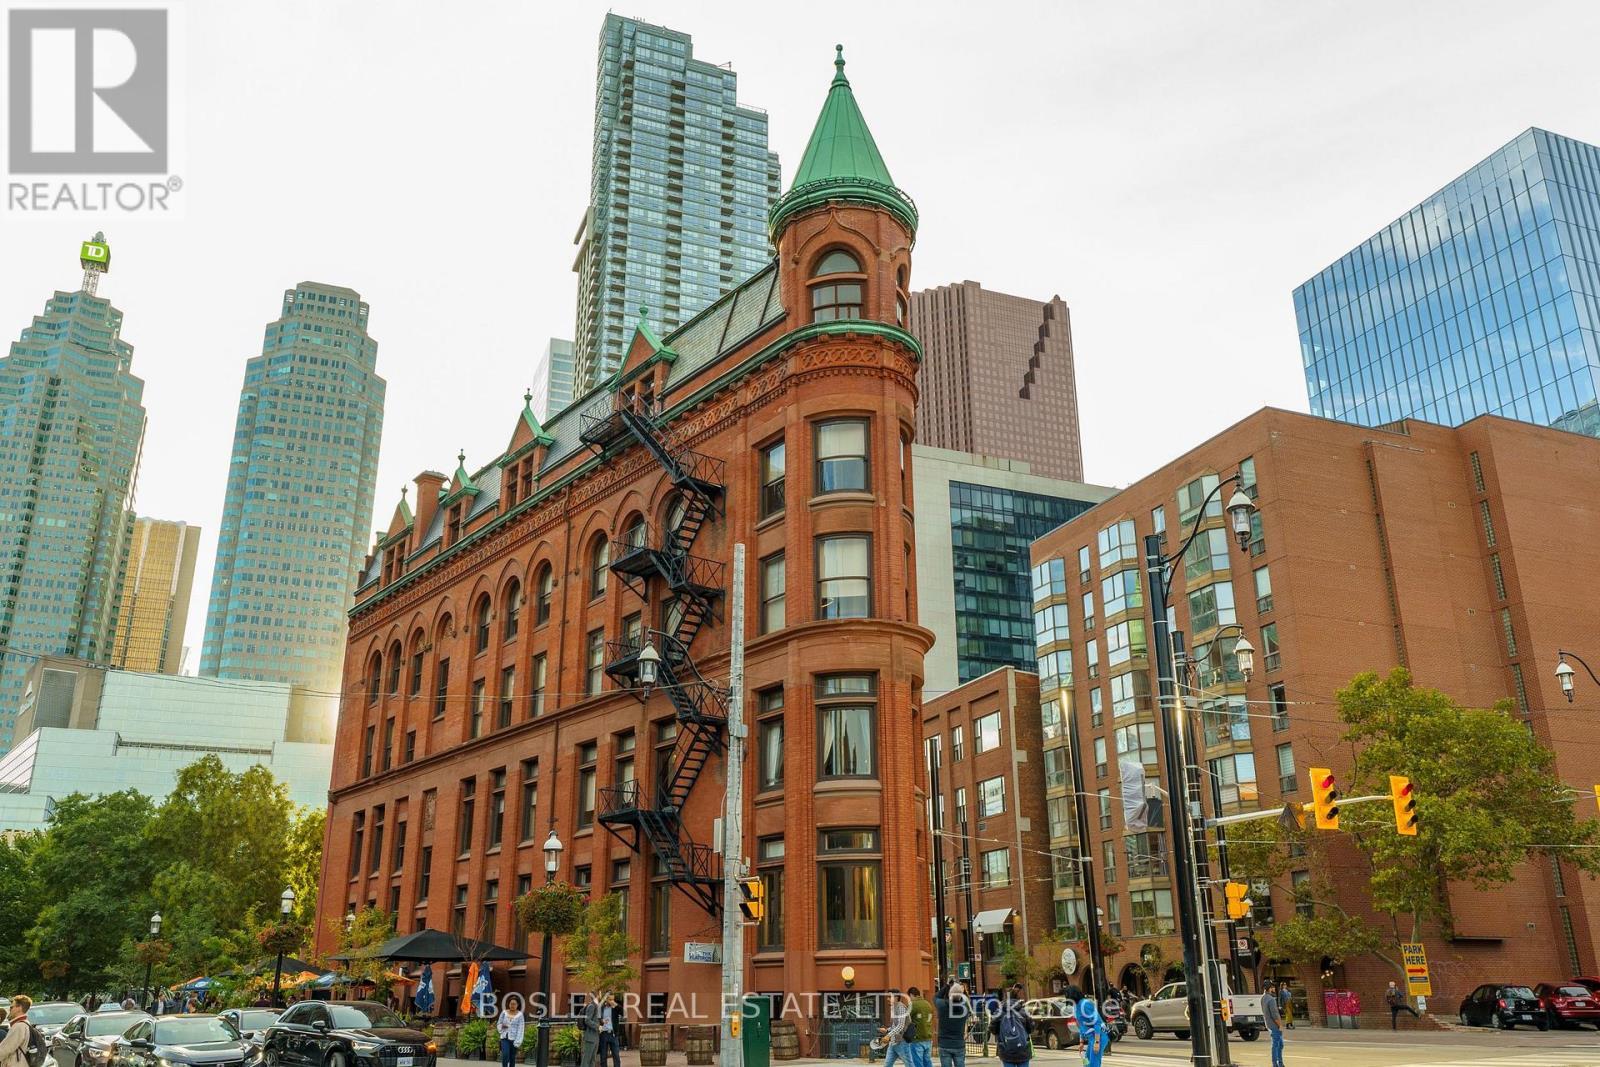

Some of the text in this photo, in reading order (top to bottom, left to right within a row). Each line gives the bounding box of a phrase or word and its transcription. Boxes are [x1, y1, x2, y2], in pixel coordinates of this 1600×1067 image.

[84, 244, 105, 258] TD
[1403, 945, 1423, 954] PARK
[1406, 956, 1425, 965] HERE
